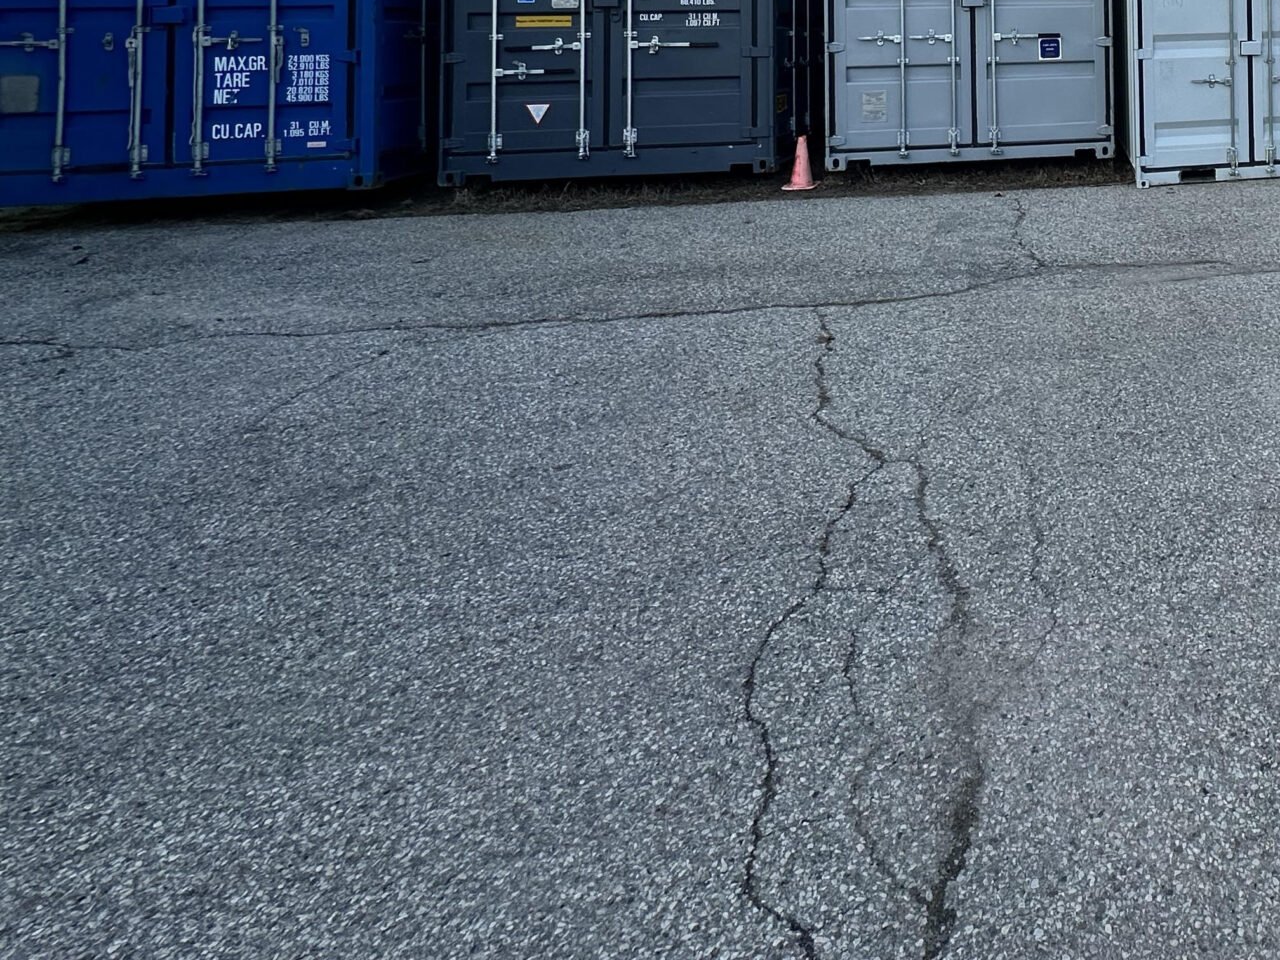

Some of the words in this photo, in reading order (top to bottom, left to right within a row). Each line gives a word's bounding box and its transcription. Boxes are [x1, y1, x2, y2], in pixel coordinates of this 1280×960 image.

[315, 54, 330, 62] KGS
[288, 62, 315, 71] 52.910
[315, 61, 330, 70] LBS
[314, 70, 330, 79] KGS
[214, 72, 251, 88] TARE
[314, 77, 330, 86] LBS
[314, 86, 330, 94] KGS
[313, 93, 330, 102] LBS
[289, 121, 300, 129] 31
[283, 128, 305, 137] 1.095
